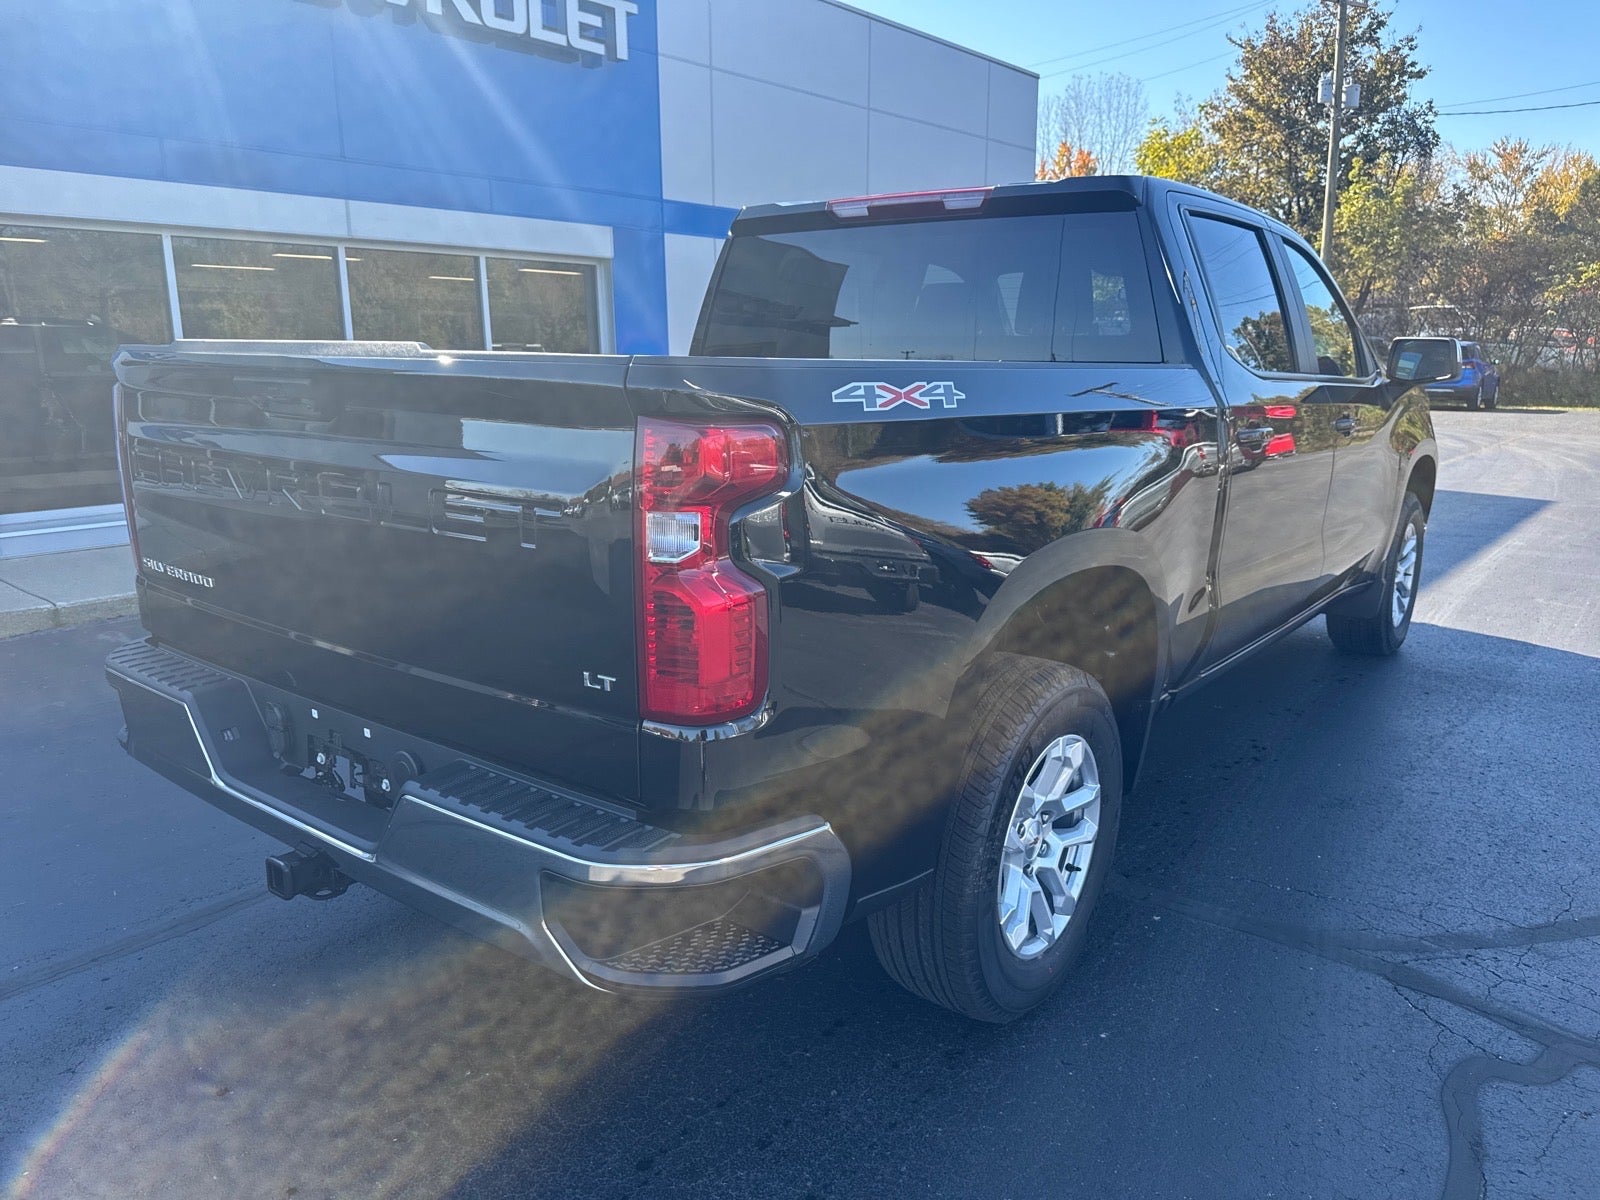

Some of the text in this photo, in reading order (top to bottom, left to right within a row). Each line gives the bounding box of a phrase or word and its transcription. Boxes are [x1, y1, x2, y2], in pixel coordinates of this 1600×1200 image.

[132, 438, 563, 549] CHEVROLET
[142, 557, 214, 588] SILVERADO
[583, 671, 617, 692] LT
